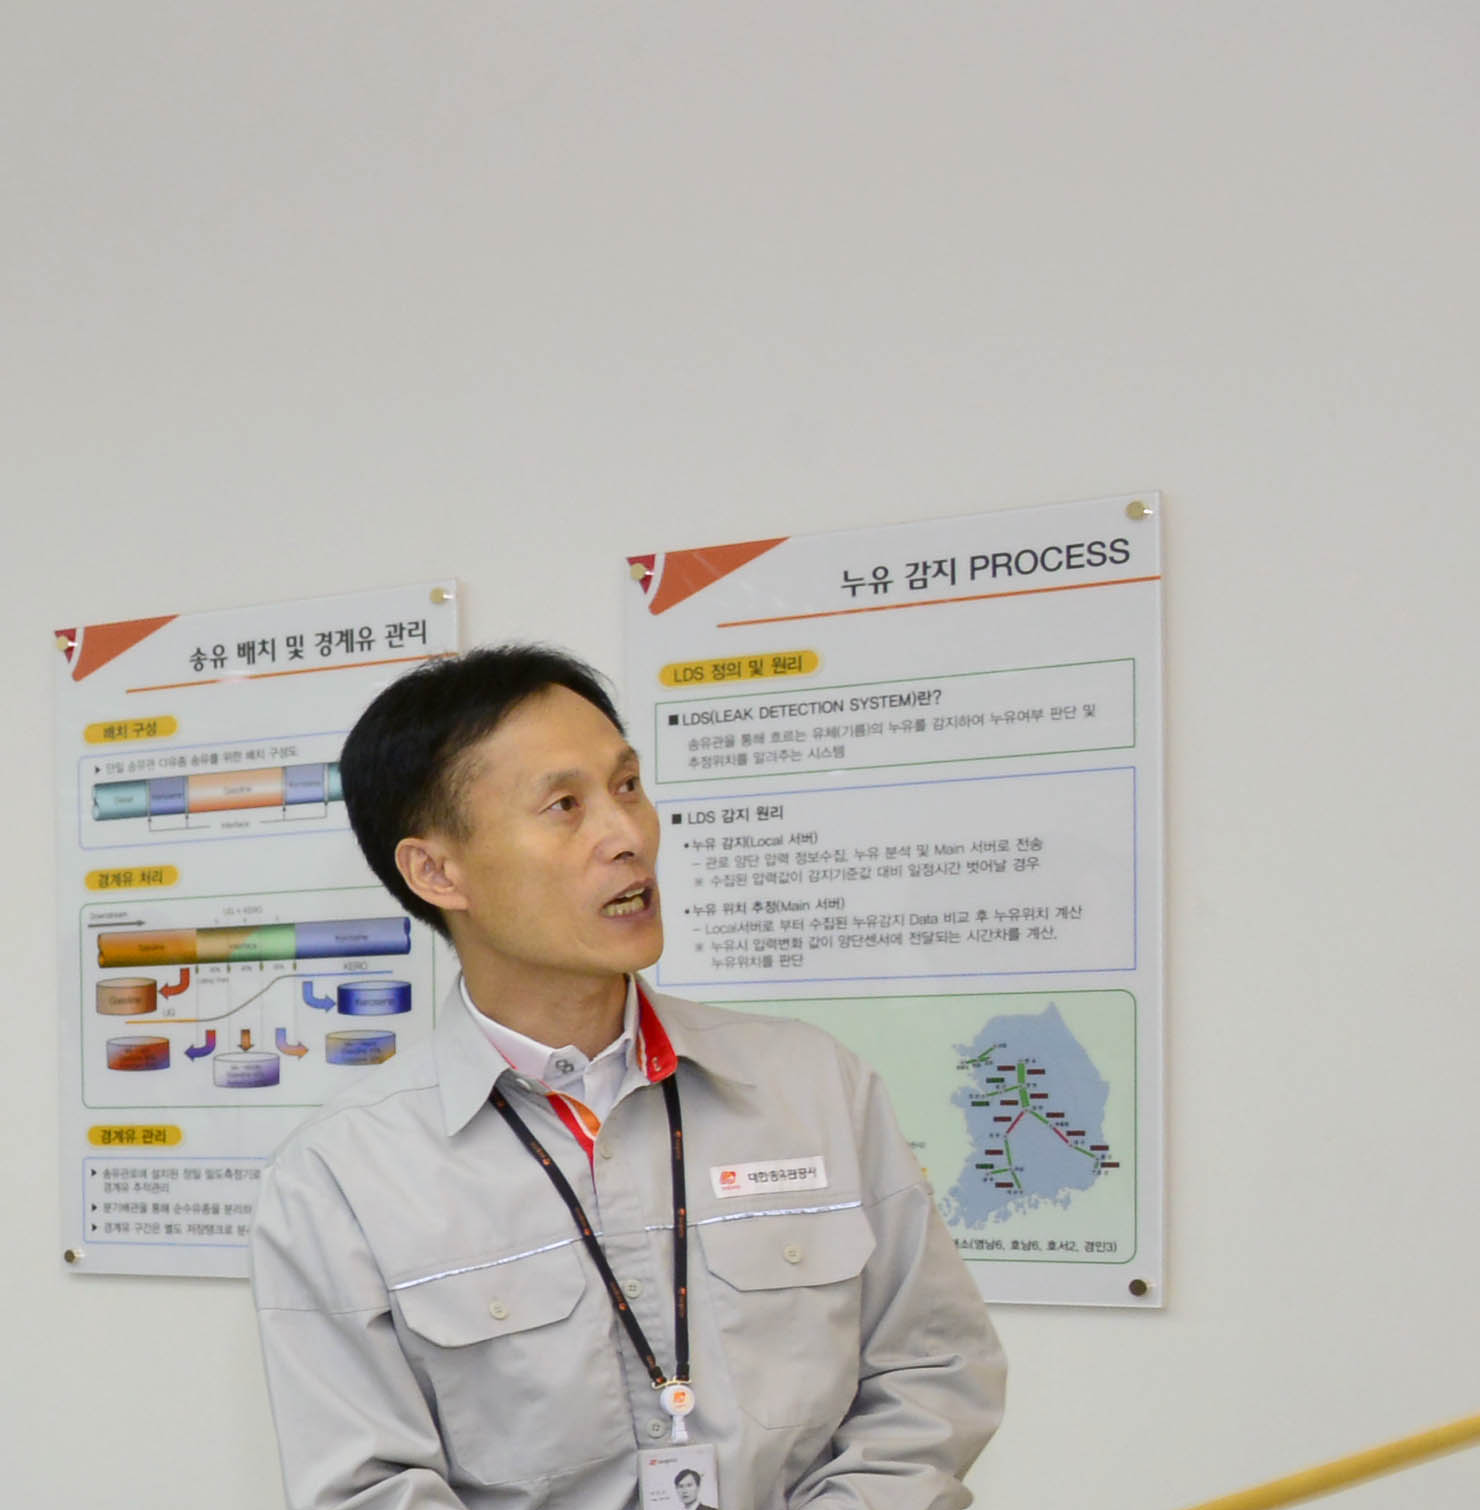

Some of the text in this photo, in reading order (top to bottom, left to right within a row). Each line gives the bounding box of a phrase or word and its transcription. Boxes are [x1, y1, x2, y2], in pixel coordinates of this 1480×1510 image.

[841, 537, 1131, 597] 누유 감지 PROCESS
[189, 618, 428, 672] 송유 배치 및 경계유 관리
[673, 655, 803, 683] LDS 정의 및 원리
[682, 688, 942, 726] LDS(LEAK DETECTION SYSTEM)란?
[933, 712, 985, 731] 감지하여
[687, 804, 784, 825] LDS 감지 원리
[692, 838, 716, 852] 누유
